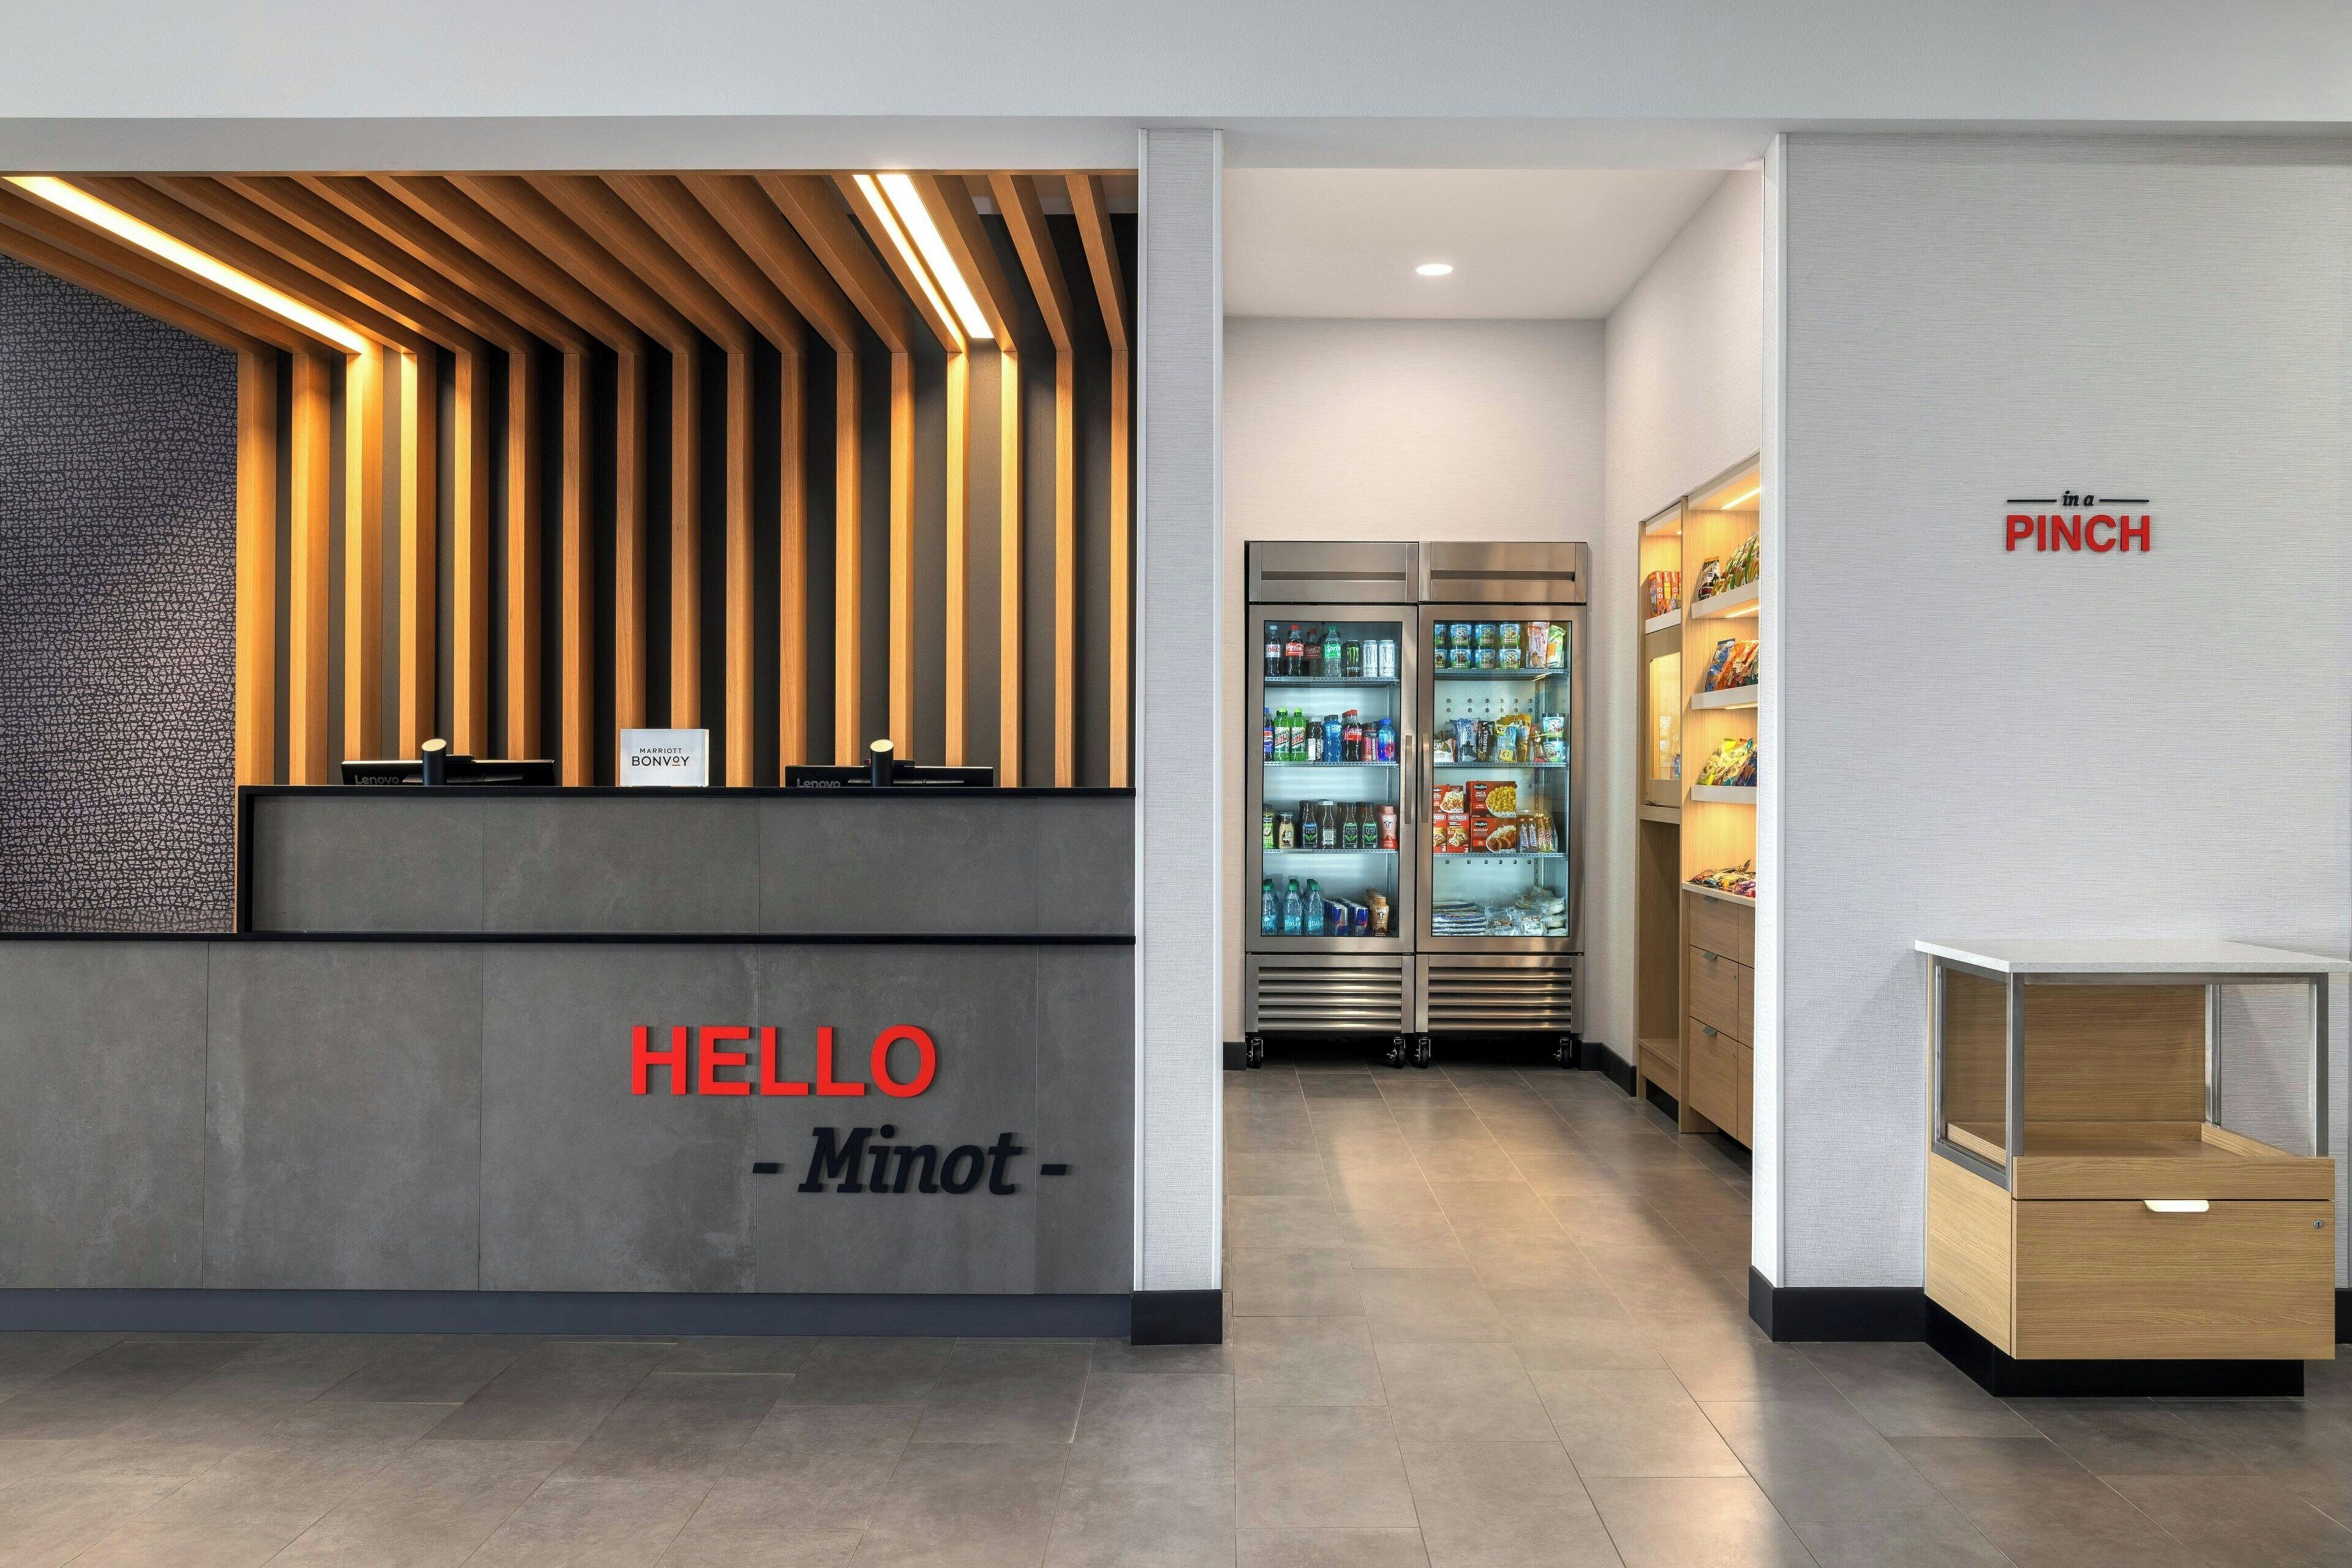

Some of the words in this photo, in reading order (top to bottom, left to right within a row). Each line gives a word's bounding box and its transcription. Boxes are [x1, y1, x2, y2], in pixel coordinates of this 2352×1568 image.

[2063, 491, 2079, 506] in
[2084, 494, 2094, 506] a
[2007, 514, 2150, 552] PINCH
[355, 775, 399, 785] Lenovo
[797, 778, 841, 788] Lenovo
[631, 1024, 937, 1098] HELLO
[797, 1124, 1025, 1195] Minot
